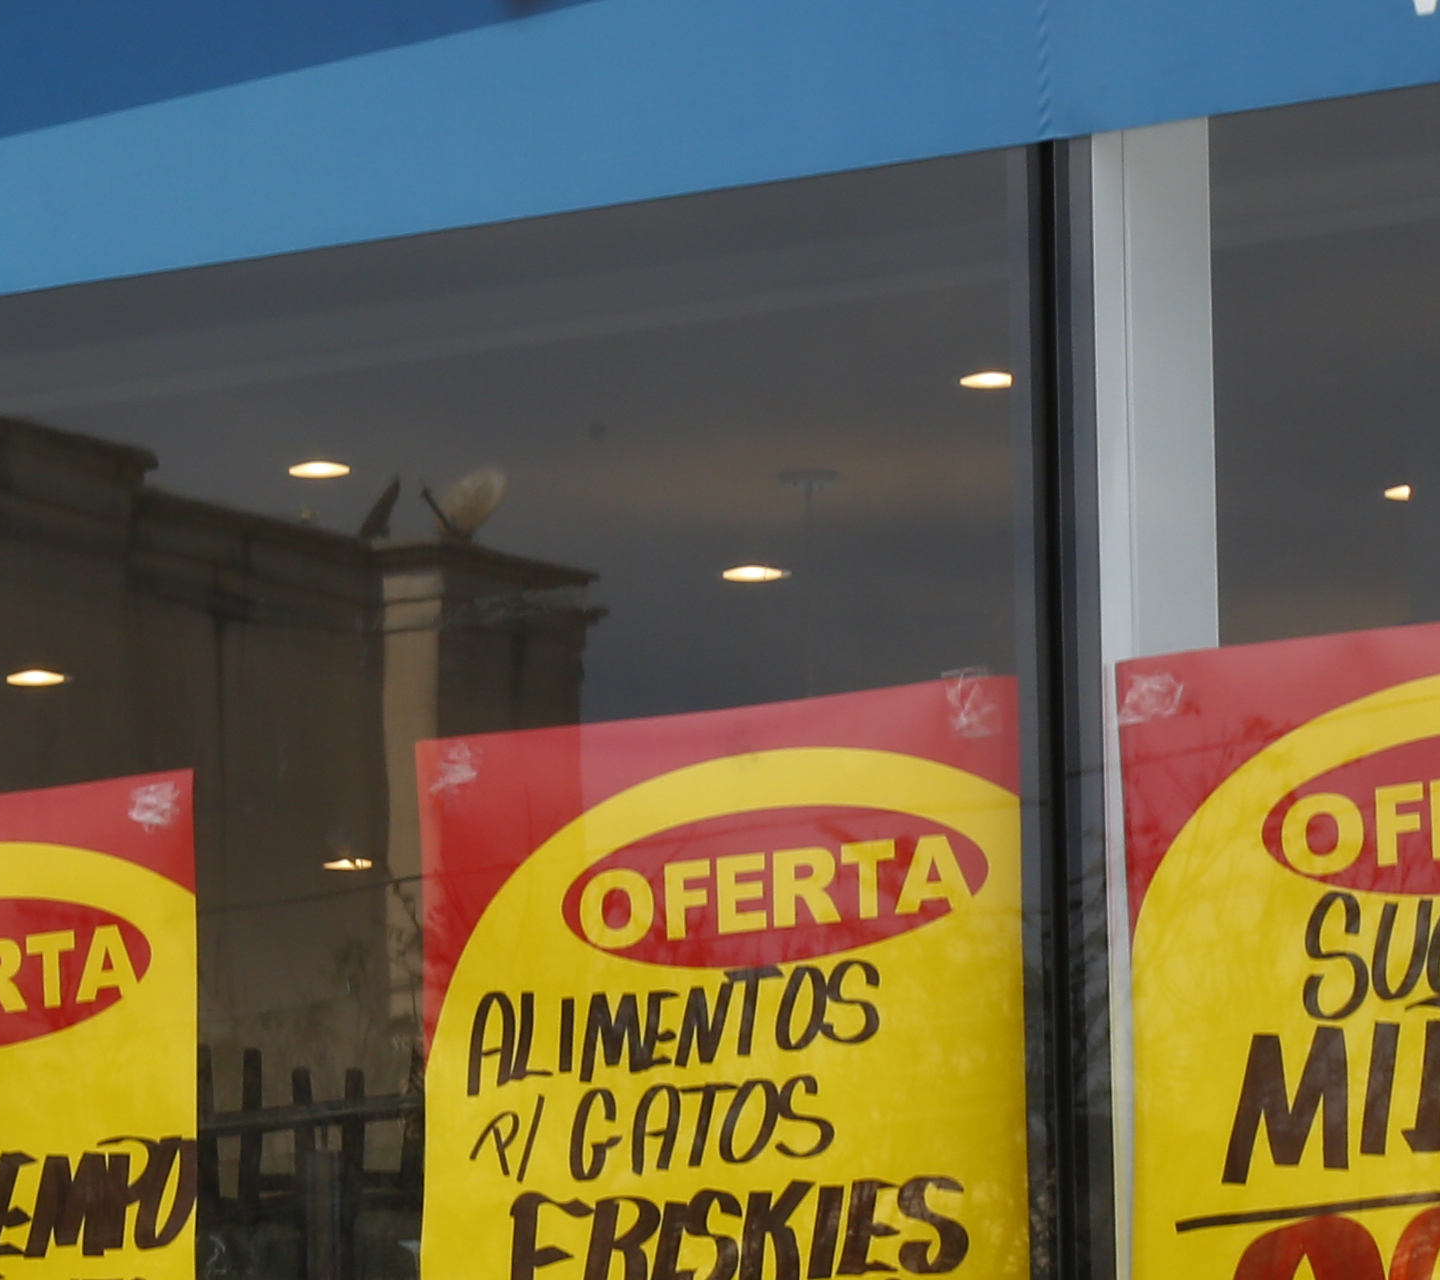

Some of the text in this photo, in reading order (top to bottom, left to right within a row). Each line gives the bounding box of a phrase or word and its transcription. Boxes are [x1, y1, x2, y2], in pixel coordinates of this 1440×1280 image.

[579, 833, 973, 949] OFERTA
[467, 960, 880, 1098] ALIMENTOS
[570, 1075, 835, 1183] GATOS
